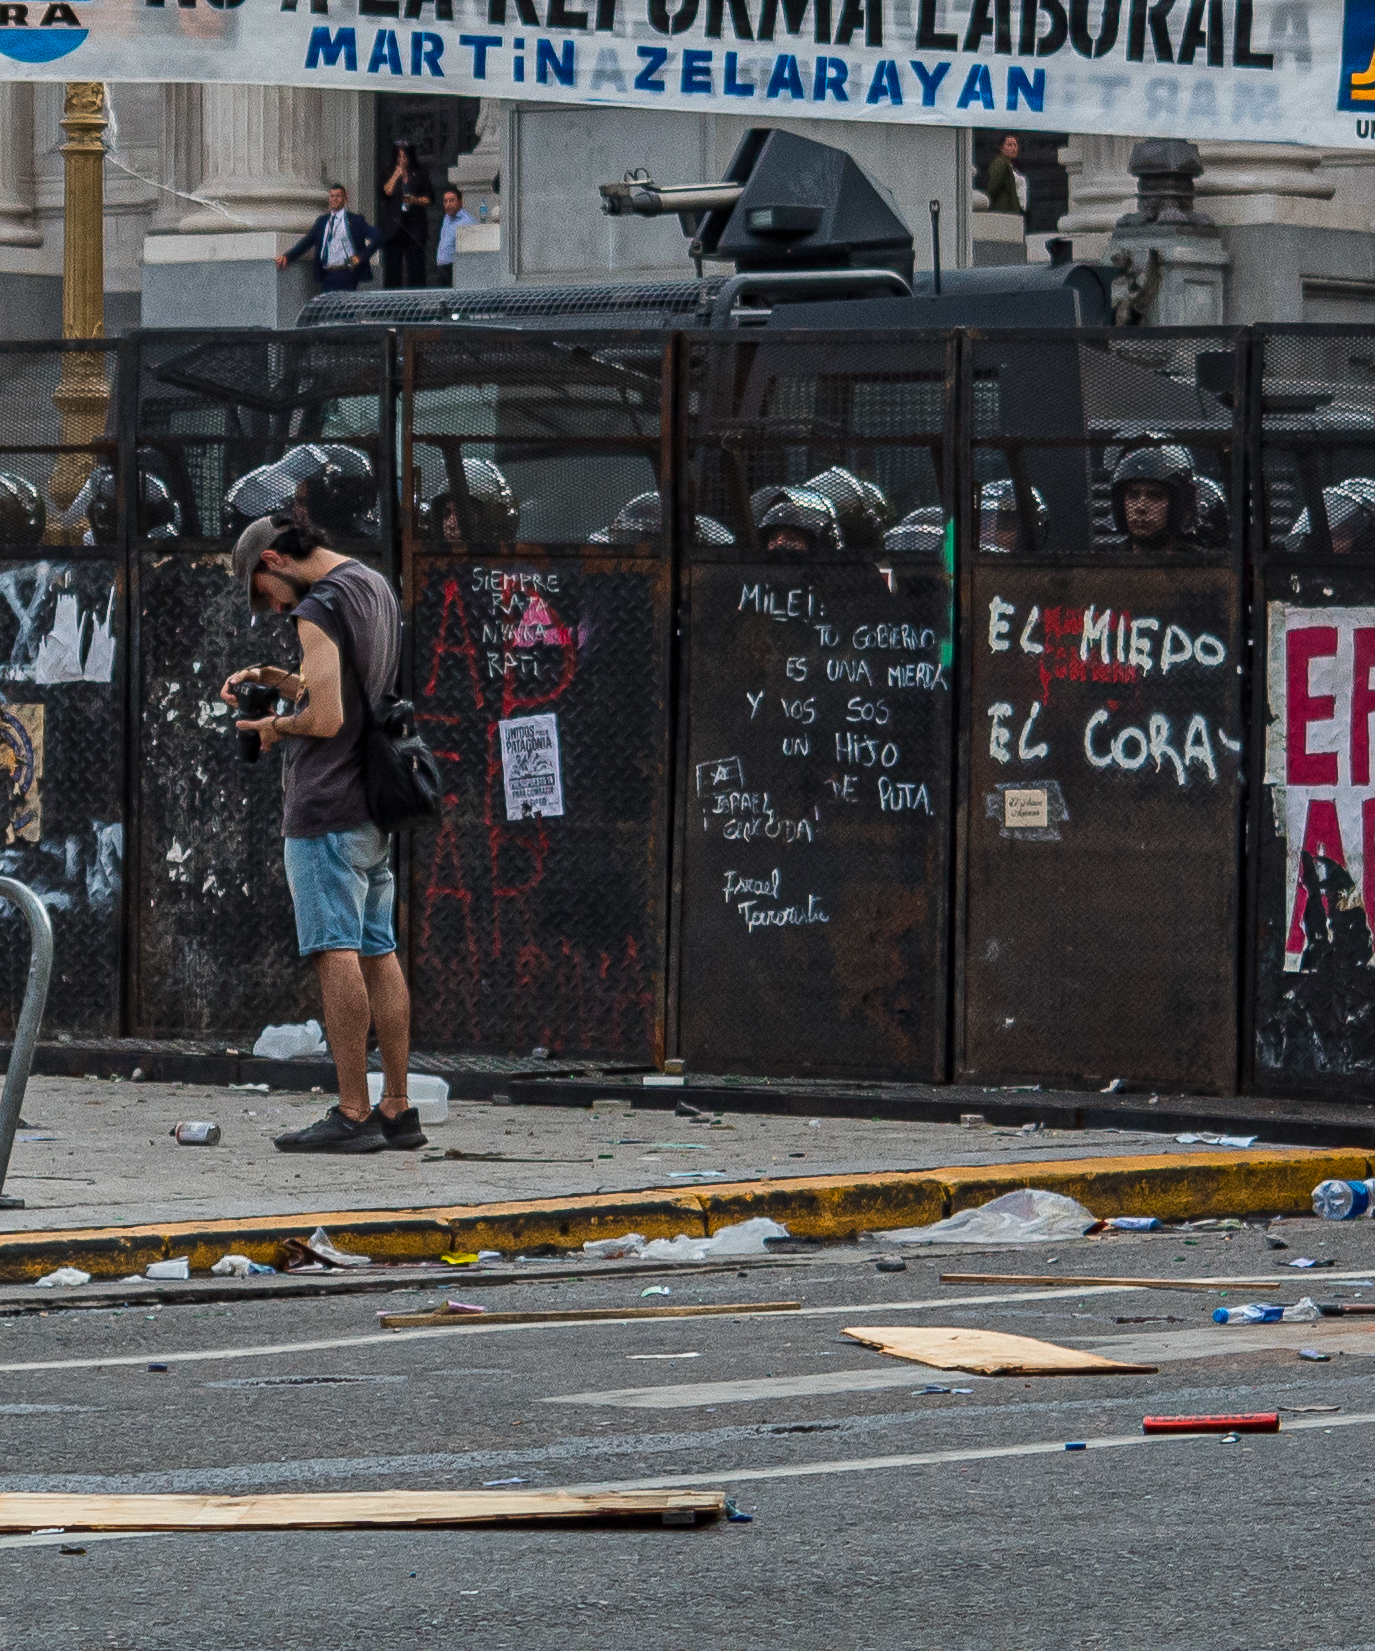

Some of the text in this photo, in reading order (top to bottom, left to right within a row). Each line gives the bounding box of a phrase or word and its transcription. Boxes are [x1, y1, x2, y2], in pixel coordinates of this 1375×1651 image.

[634, 46, 1047, 114] ZELARAYAN
[814, 625, 839, 647] TU
[988, 595, 1045, 654] EL
[1080, 603, 1226, 677] MIEDO
[786, 657, 808, 682] ES
[827, 659, 873, 687] UNA
[746, 690, 890, 725] Y VOS SOS
[782, 735, 810, 757] UN
[987, 701, 1048, 764] EL
